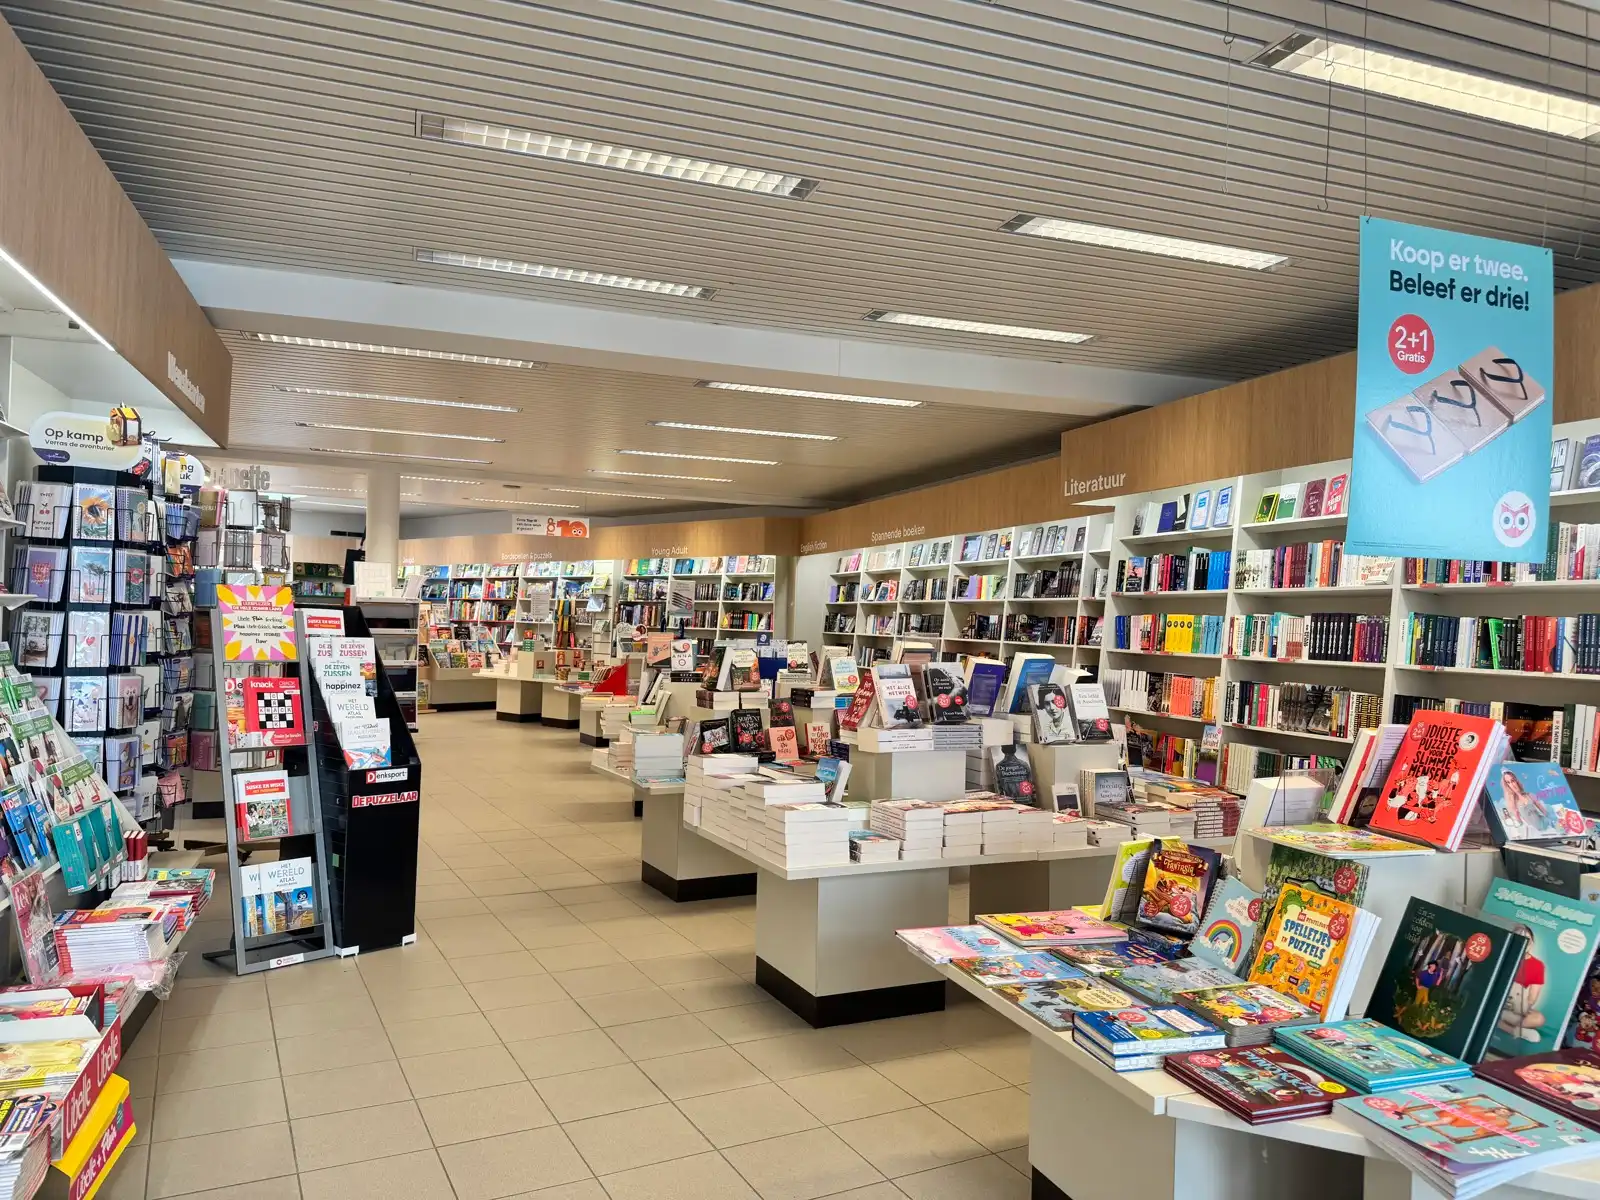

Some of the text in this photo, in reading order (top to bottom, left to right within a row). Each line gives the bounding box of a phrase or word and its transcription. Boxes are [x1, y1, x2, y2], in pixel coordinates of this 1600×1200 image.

[1390, 238, 1529, 282] Koop er twee.
[1390, 270, 1530, 311] Beleef er drie!
[1394, 326, 1429, 351] 2+1
[1397, 350, 1426, 363] Gratis
[44, 427, 104, 443] Op kamp
[44, 439, 68, 447] Verras
[1064, 473, 1126, 497] Literatuur
[871, 525, 926, 544] Spannende boeken
[652, 546, 689, 558] Young Adult
[250, 680, 275, 688] knack
[326, 683, 361, 691] happinez
[1426, 724, 1463, 743] IDIOTE
[1419, 738, 1460, 756] PUZZELS
[1428, 750, 1444, 758] VOOR
[1413, 751, 1454, 770] SLIMME
[367, 770, 405, 783] Denksport
[1407, 764, 1450, 781] MENSEN
[268, 867, 305, 880] WERELD
[1337, 876, 1352, 886] 2+1
[1174, 900, 1188, 912] 2+1
[1283, 918, 1331, 948] SPELLETJES
[1288, 935, 1326, 960] PUZZELS
[1469, 940, 1487, 955] 2+1
[96, 1028, 119, 1087] Libelle
[65, 1072, 92, 1140] Libelle
